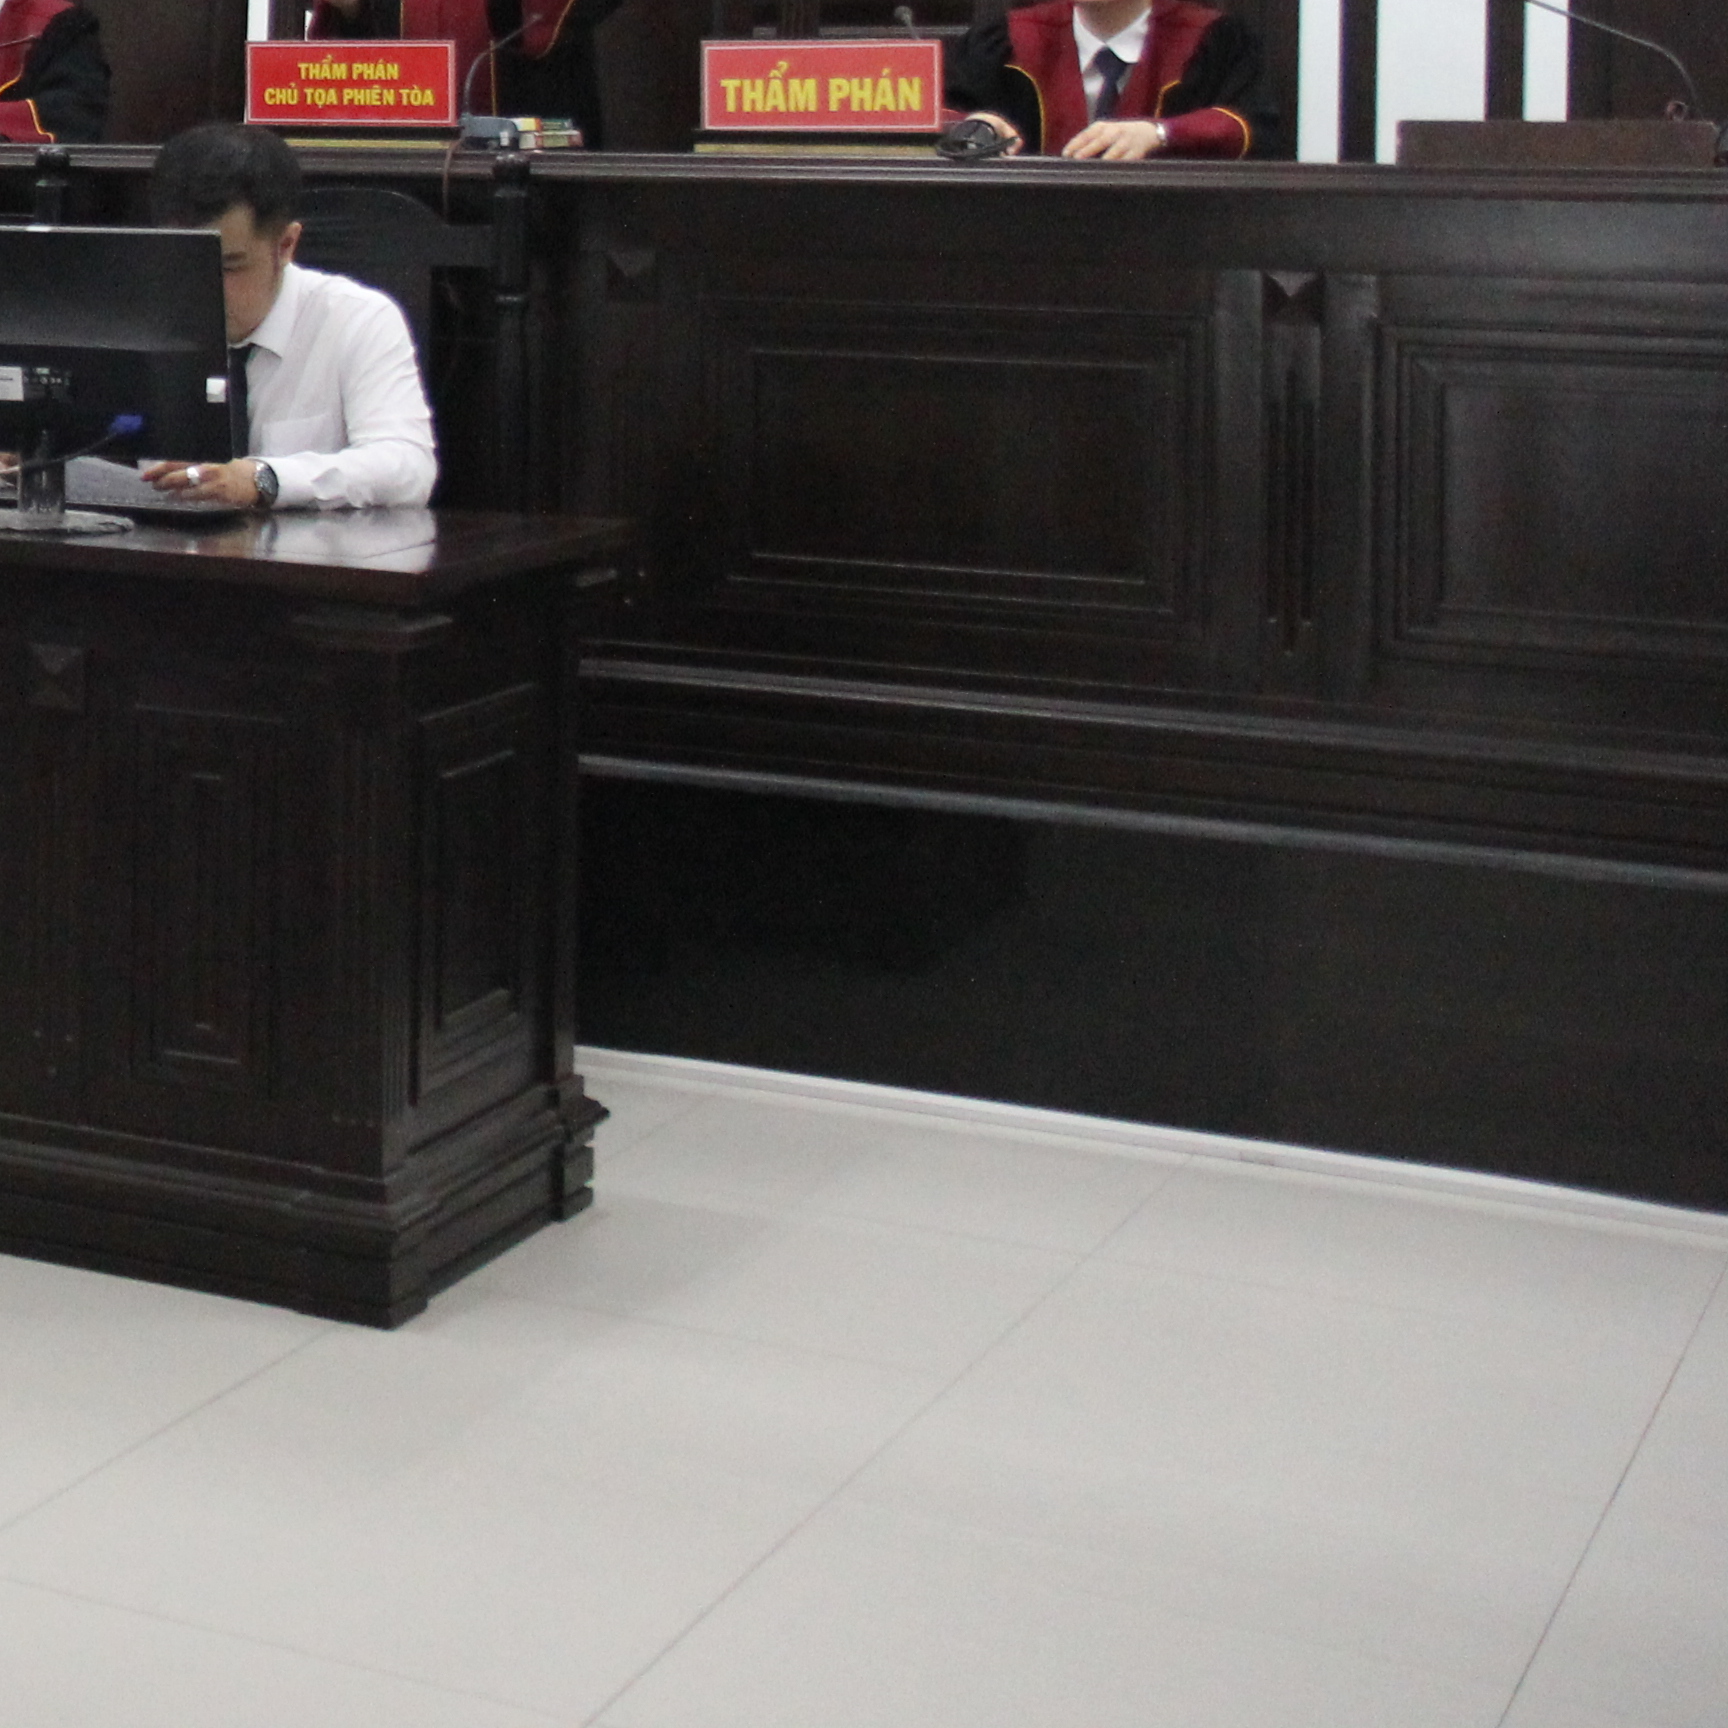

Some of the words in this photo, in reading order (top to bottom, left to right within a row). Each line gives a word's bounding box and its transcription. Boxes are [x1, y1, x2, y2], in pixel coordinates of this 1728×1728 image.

[298, 54, 347, 80] THẨM
[352, 59, 399, 80] PHÁN
[264, 83, 298, 105] CHỦ
[304, 88, 338, 108] TỌA
[343, 85, 395, 106] PHIÊN
[399, 85, 435, 106] TÒA
[720, 61, 818, 112] THẨM
[828, 67, 922, 111] PHÁN
